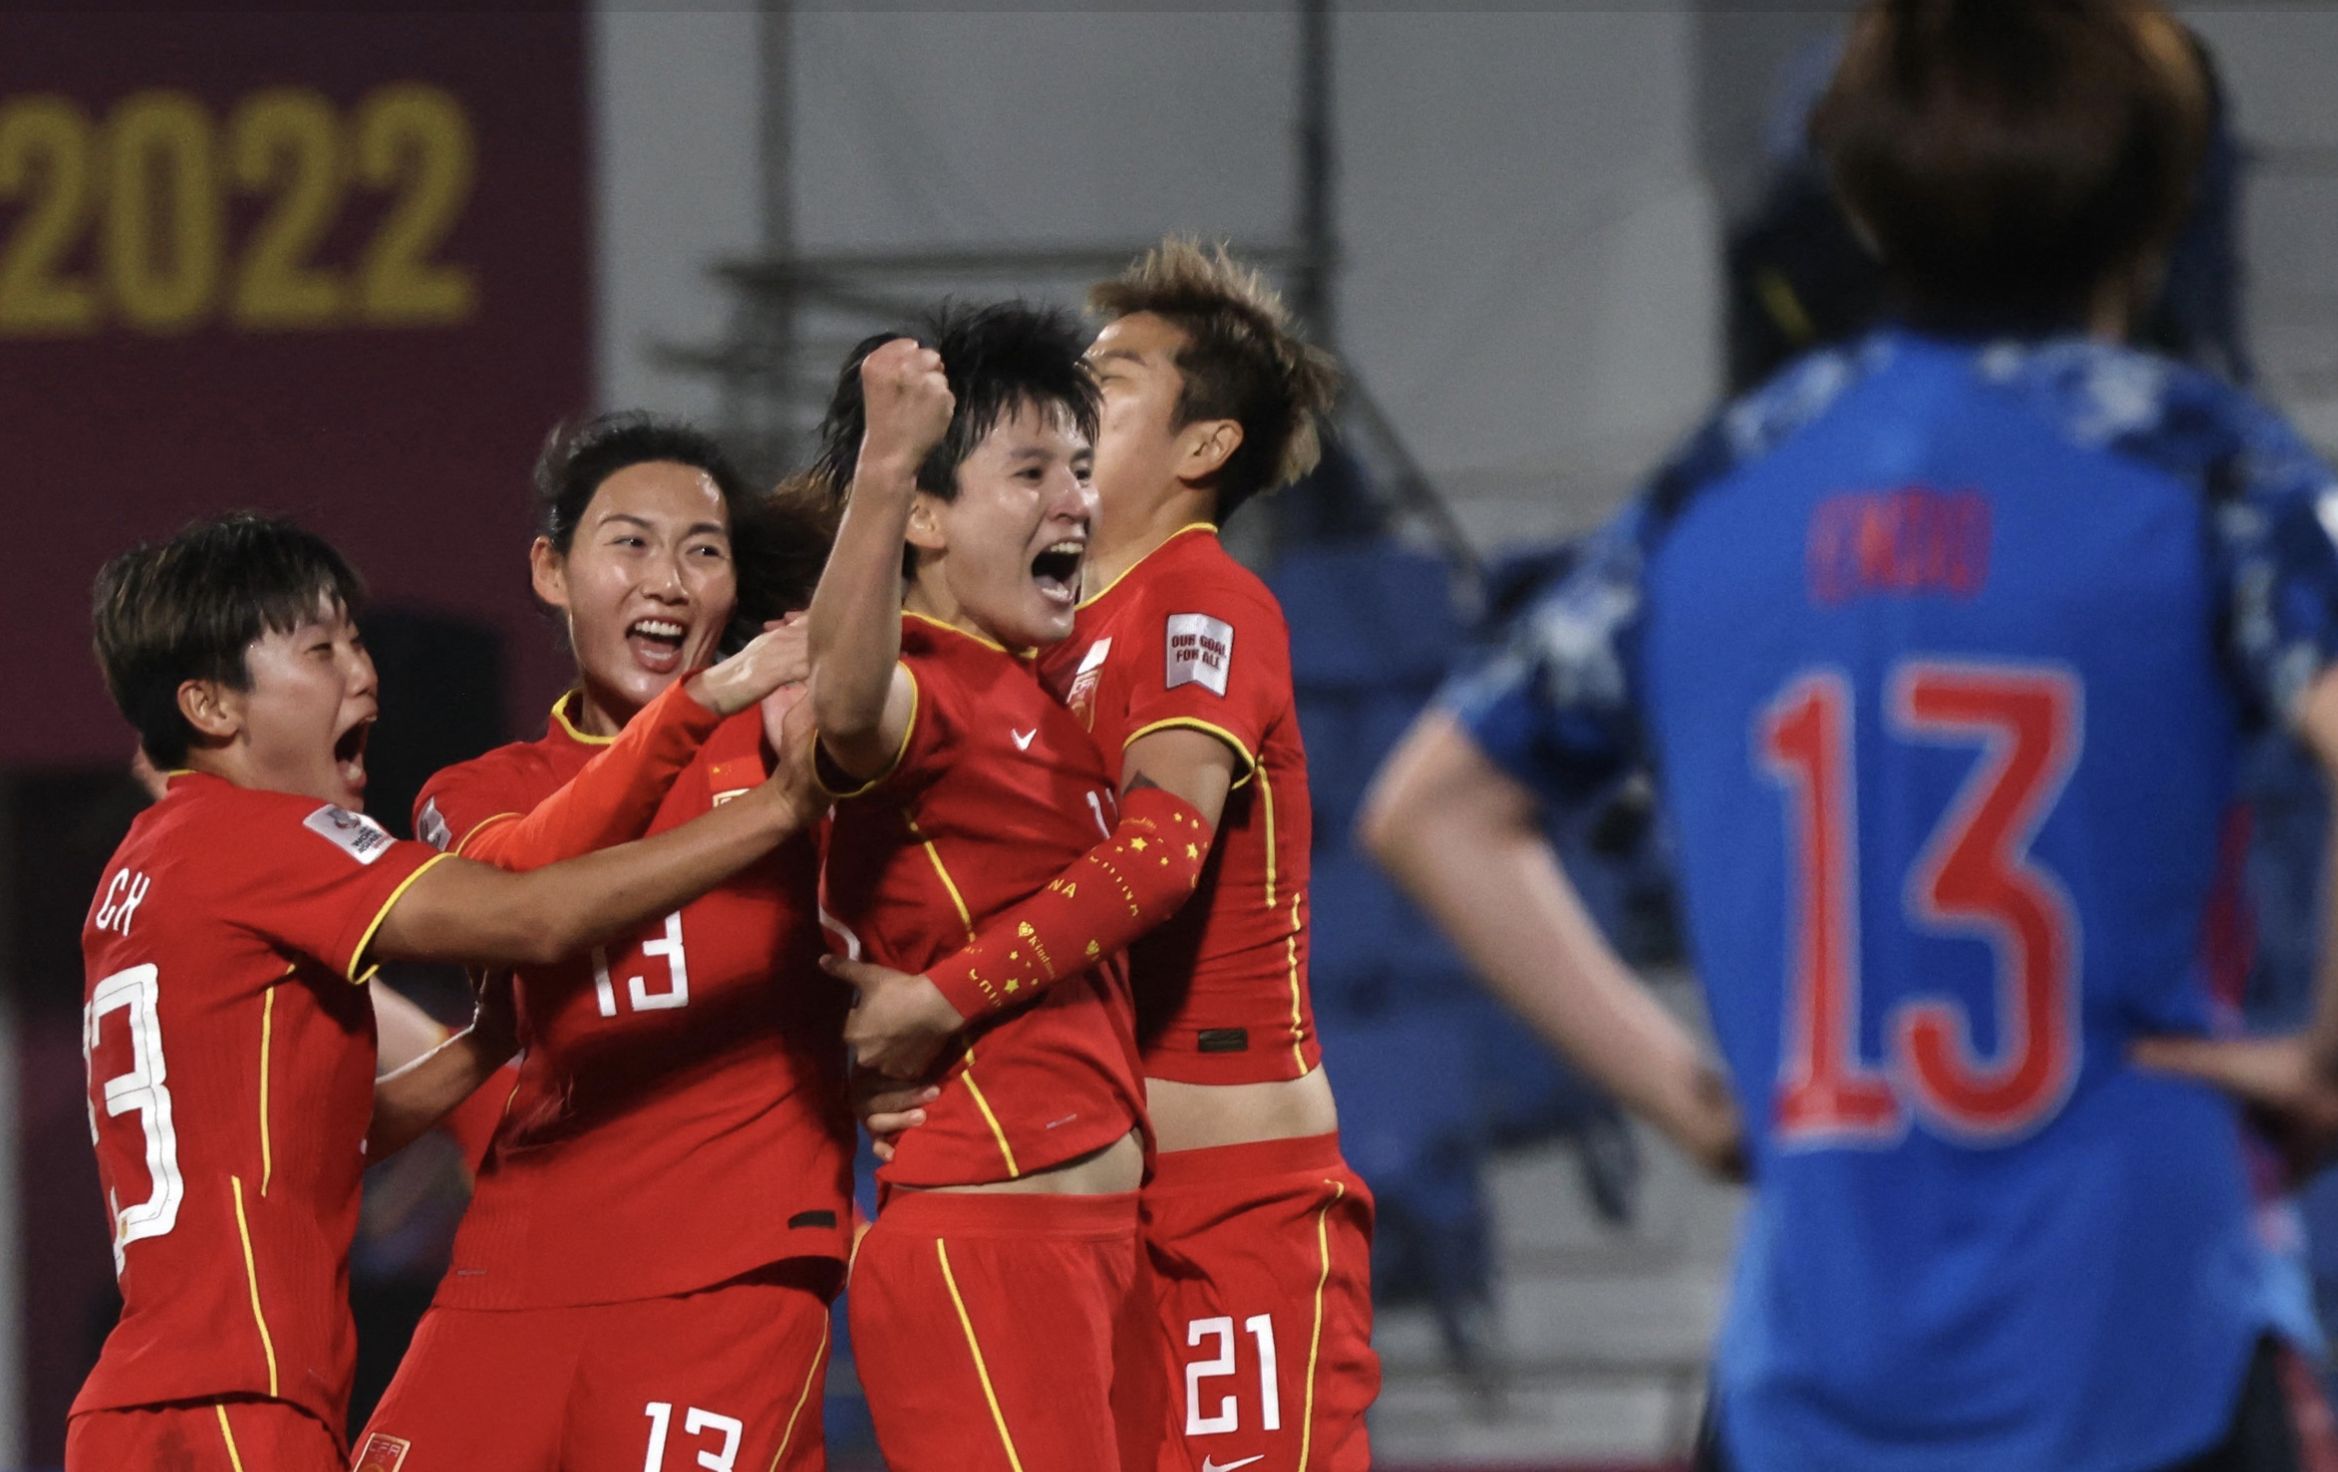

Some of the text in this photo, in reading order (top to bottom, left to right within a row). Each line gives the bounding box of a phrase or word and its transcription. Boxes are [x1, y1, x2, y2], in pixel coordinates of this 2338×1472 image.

[0, 88, 476, 334] 2022
[1171, 634, 1227, 659] OUR GOAL
[1176, 649, 1219, 670] FOR ALL
[1752, 658, 2087, 1148] 13
[1185, 1313, 1281, 1436] 21
